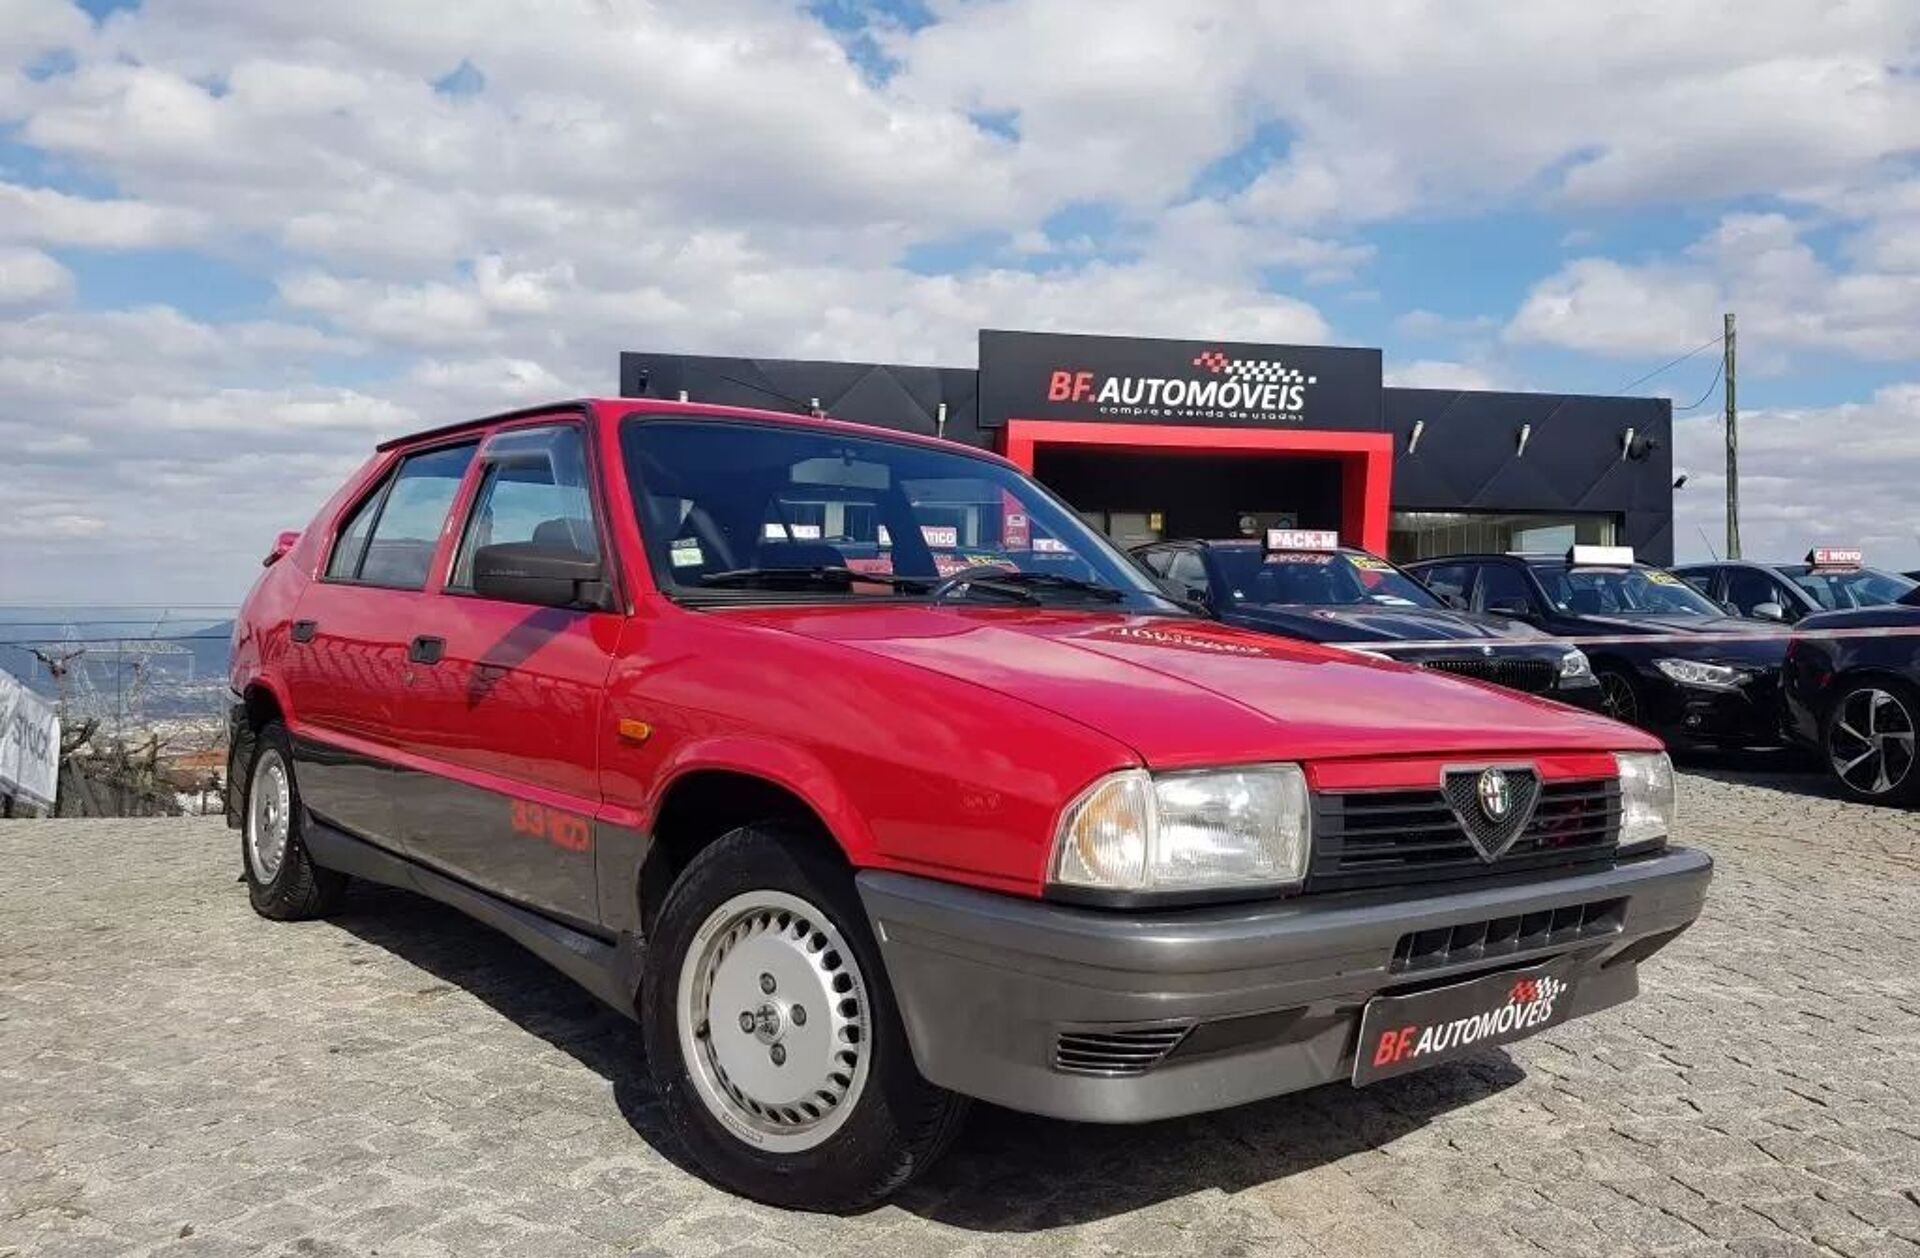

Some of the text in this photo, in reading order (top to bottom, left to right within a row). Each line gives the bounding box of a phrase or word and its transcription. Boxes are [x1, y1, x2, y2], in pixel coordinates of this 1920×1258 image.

[1099, 406, 1305, 422] compra e venda de usados
[1270, 532, 1335, 549] PACK-M
